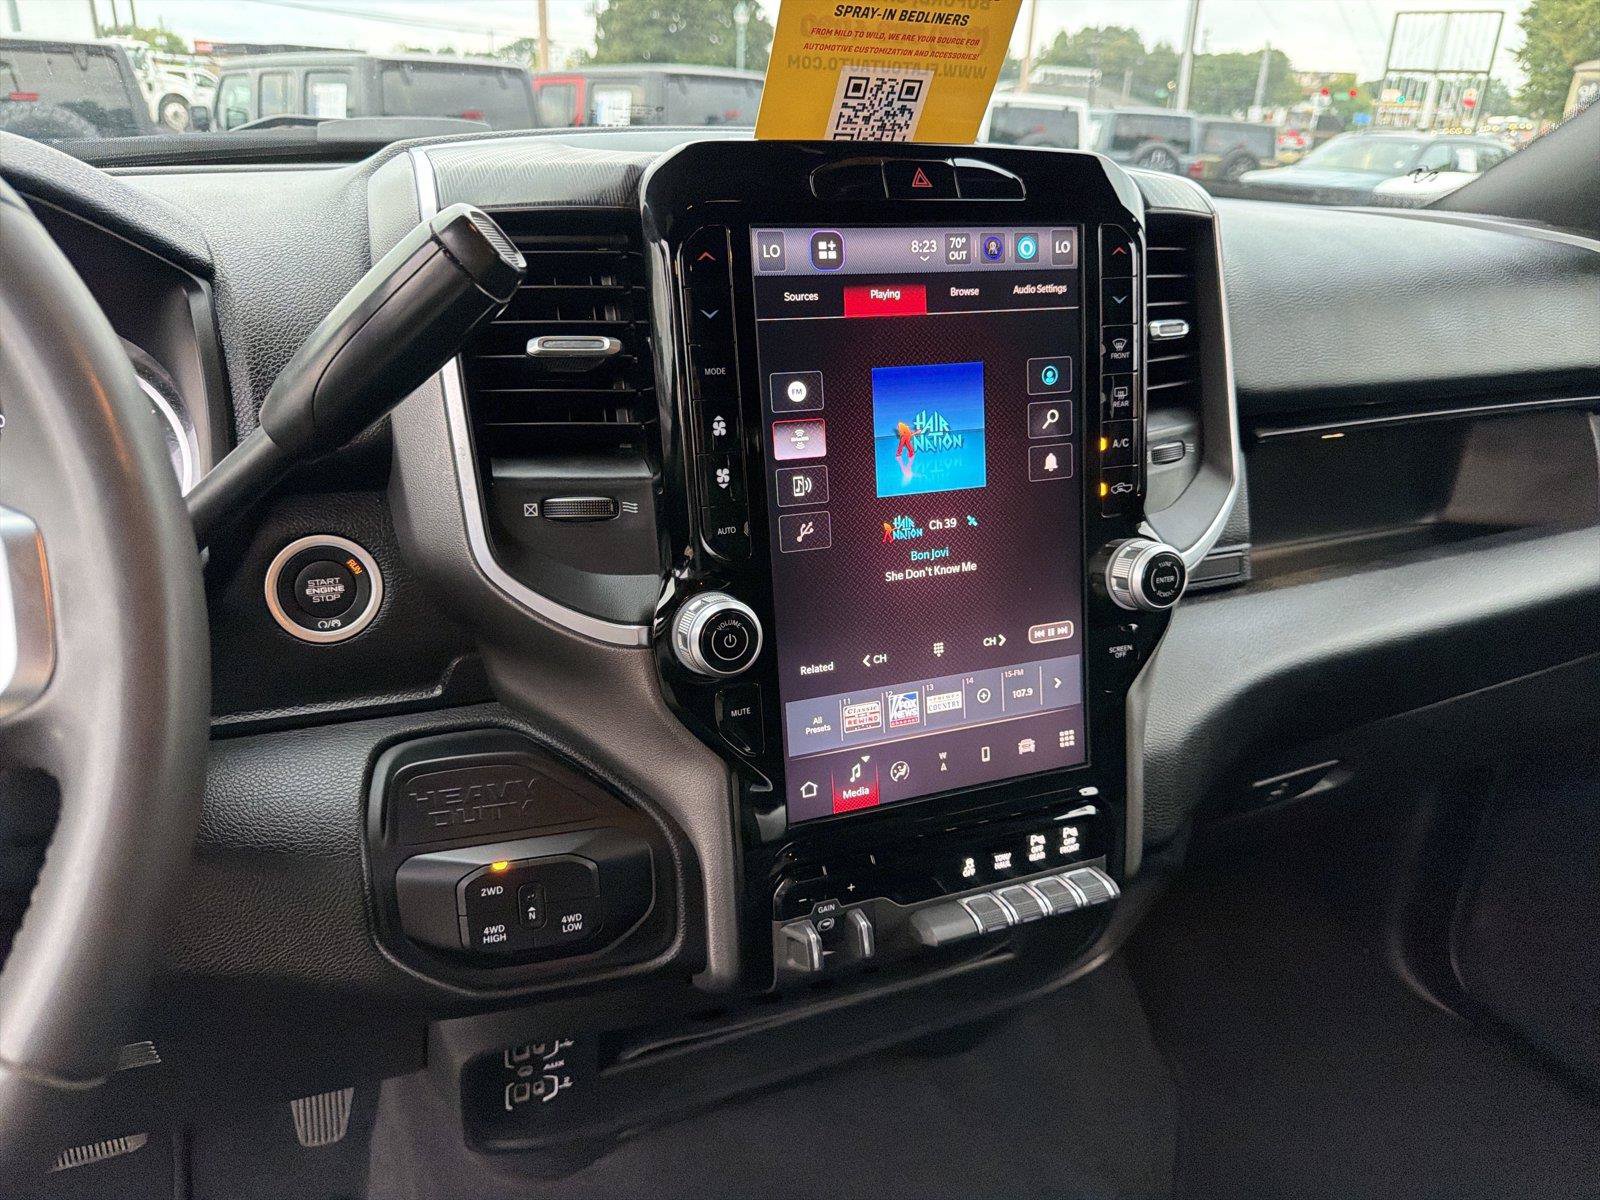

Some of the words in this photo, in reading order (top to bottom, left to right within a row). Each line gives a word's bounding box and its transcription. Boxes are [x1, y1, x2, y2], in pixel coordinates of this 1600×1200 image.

[834, 5, 897, 21] SPRAY-IN
[899, 11, 971, 27] BEDLINERS
[811, 27, 833, 37] FROM
[834, 29, 852, 38] MILD
[853, 30, 864, 39] TO
[865, 31, 886, 41] WILD,
[888, 33, 900, 42] WE
[901, 34, 916, 43] ARE
[915, 35, 935, 45] YOUR
[936, 37, 965, 47] SOURCE
[965, 38, 981, 47] FOR
[803, 42, 853, 53] AUTOMOTIVE
[853, 45, 914, 57] CUSTOMIZATION
[914, 49, 929, 58] AND
[929, 50, 980, 61] ACCESSORIES!
[911, 240, 937, 253] 8:23
[949, 237, 967, 250] 70°
[1055, 241, 1071, 255] LO
[763, 244, 780, 258] LO
[949, 250, 967, 261] OUT
[870, 289, 901, 301] Playing
[950, 286, 980, 298] Browse
[1013, 284, 1035, 295] Audio
[1036, 283, 1068, 296] Settings
[784, 291, 819, 302] Sources
[1110, 352, 1130, 360] FRONT
[704, 367, 726, 375] MODE
[791, 388, 803, 396] FM
[1112, 400, 1130, 408] REAR
[913, 410, 950, 433] HAIR
[913, 430, 963, 453] NATION
[1112, 438, 1130, 448] A/C
[893, 515, 915, 529] HAIR
[929, 520, 943, 530] Ch
[944, 518, 957, 528] 39
[717, 526, 736, 535] AUTO
[892, 528, 923, 540] NATION
[911, 550, 930, 561] Bon
[930, 547, 949, 560] Jovi
[347, 558, 363, 575] RUN
[885, 571, 904, 582] She
[905, 566, 933, 579] Don't
[934, 564, 960, 576] Know
[962, 561, 977, 572] Me
[307, 577, 341, 587] START
[1156, 575, 1175, 583] ENTER
[305, 585, 345, 596] ENGINE
[312, 594, 341, 603] STOP
[716, 619, 742, 631] VOLUME
[983, 636, 997, 647] CH
[1108, 645, 1133, 653] SCREEN
[873, 654, 888, 664] CH
[800, 661, 834, 676] Related
[1004, 668, 1024, 678] 15-FM
[885, 690, 894, 699] 12
[1012, 687, 1034, 699] 107.9
[731, 707, 751, 717] MUTE
[928, 701, 961, 712] COUNTRY
[812, 716, 823, 724] All
[847, 715, 879, 726] REWIND
[805, 723, 831, 735] Presets
[842, 786, 870, 799] Media
[480, 886, 504, 897] 2WD
[817, 904, 836, 914] GAIN
[528, 912, 536, 920] N
[561, 913, 583, 924] 4WD
[483, 924, 506, 935] 4WD
[562, 922, 583, 933] LOW
[483, 933, 507, 944] HIGH
